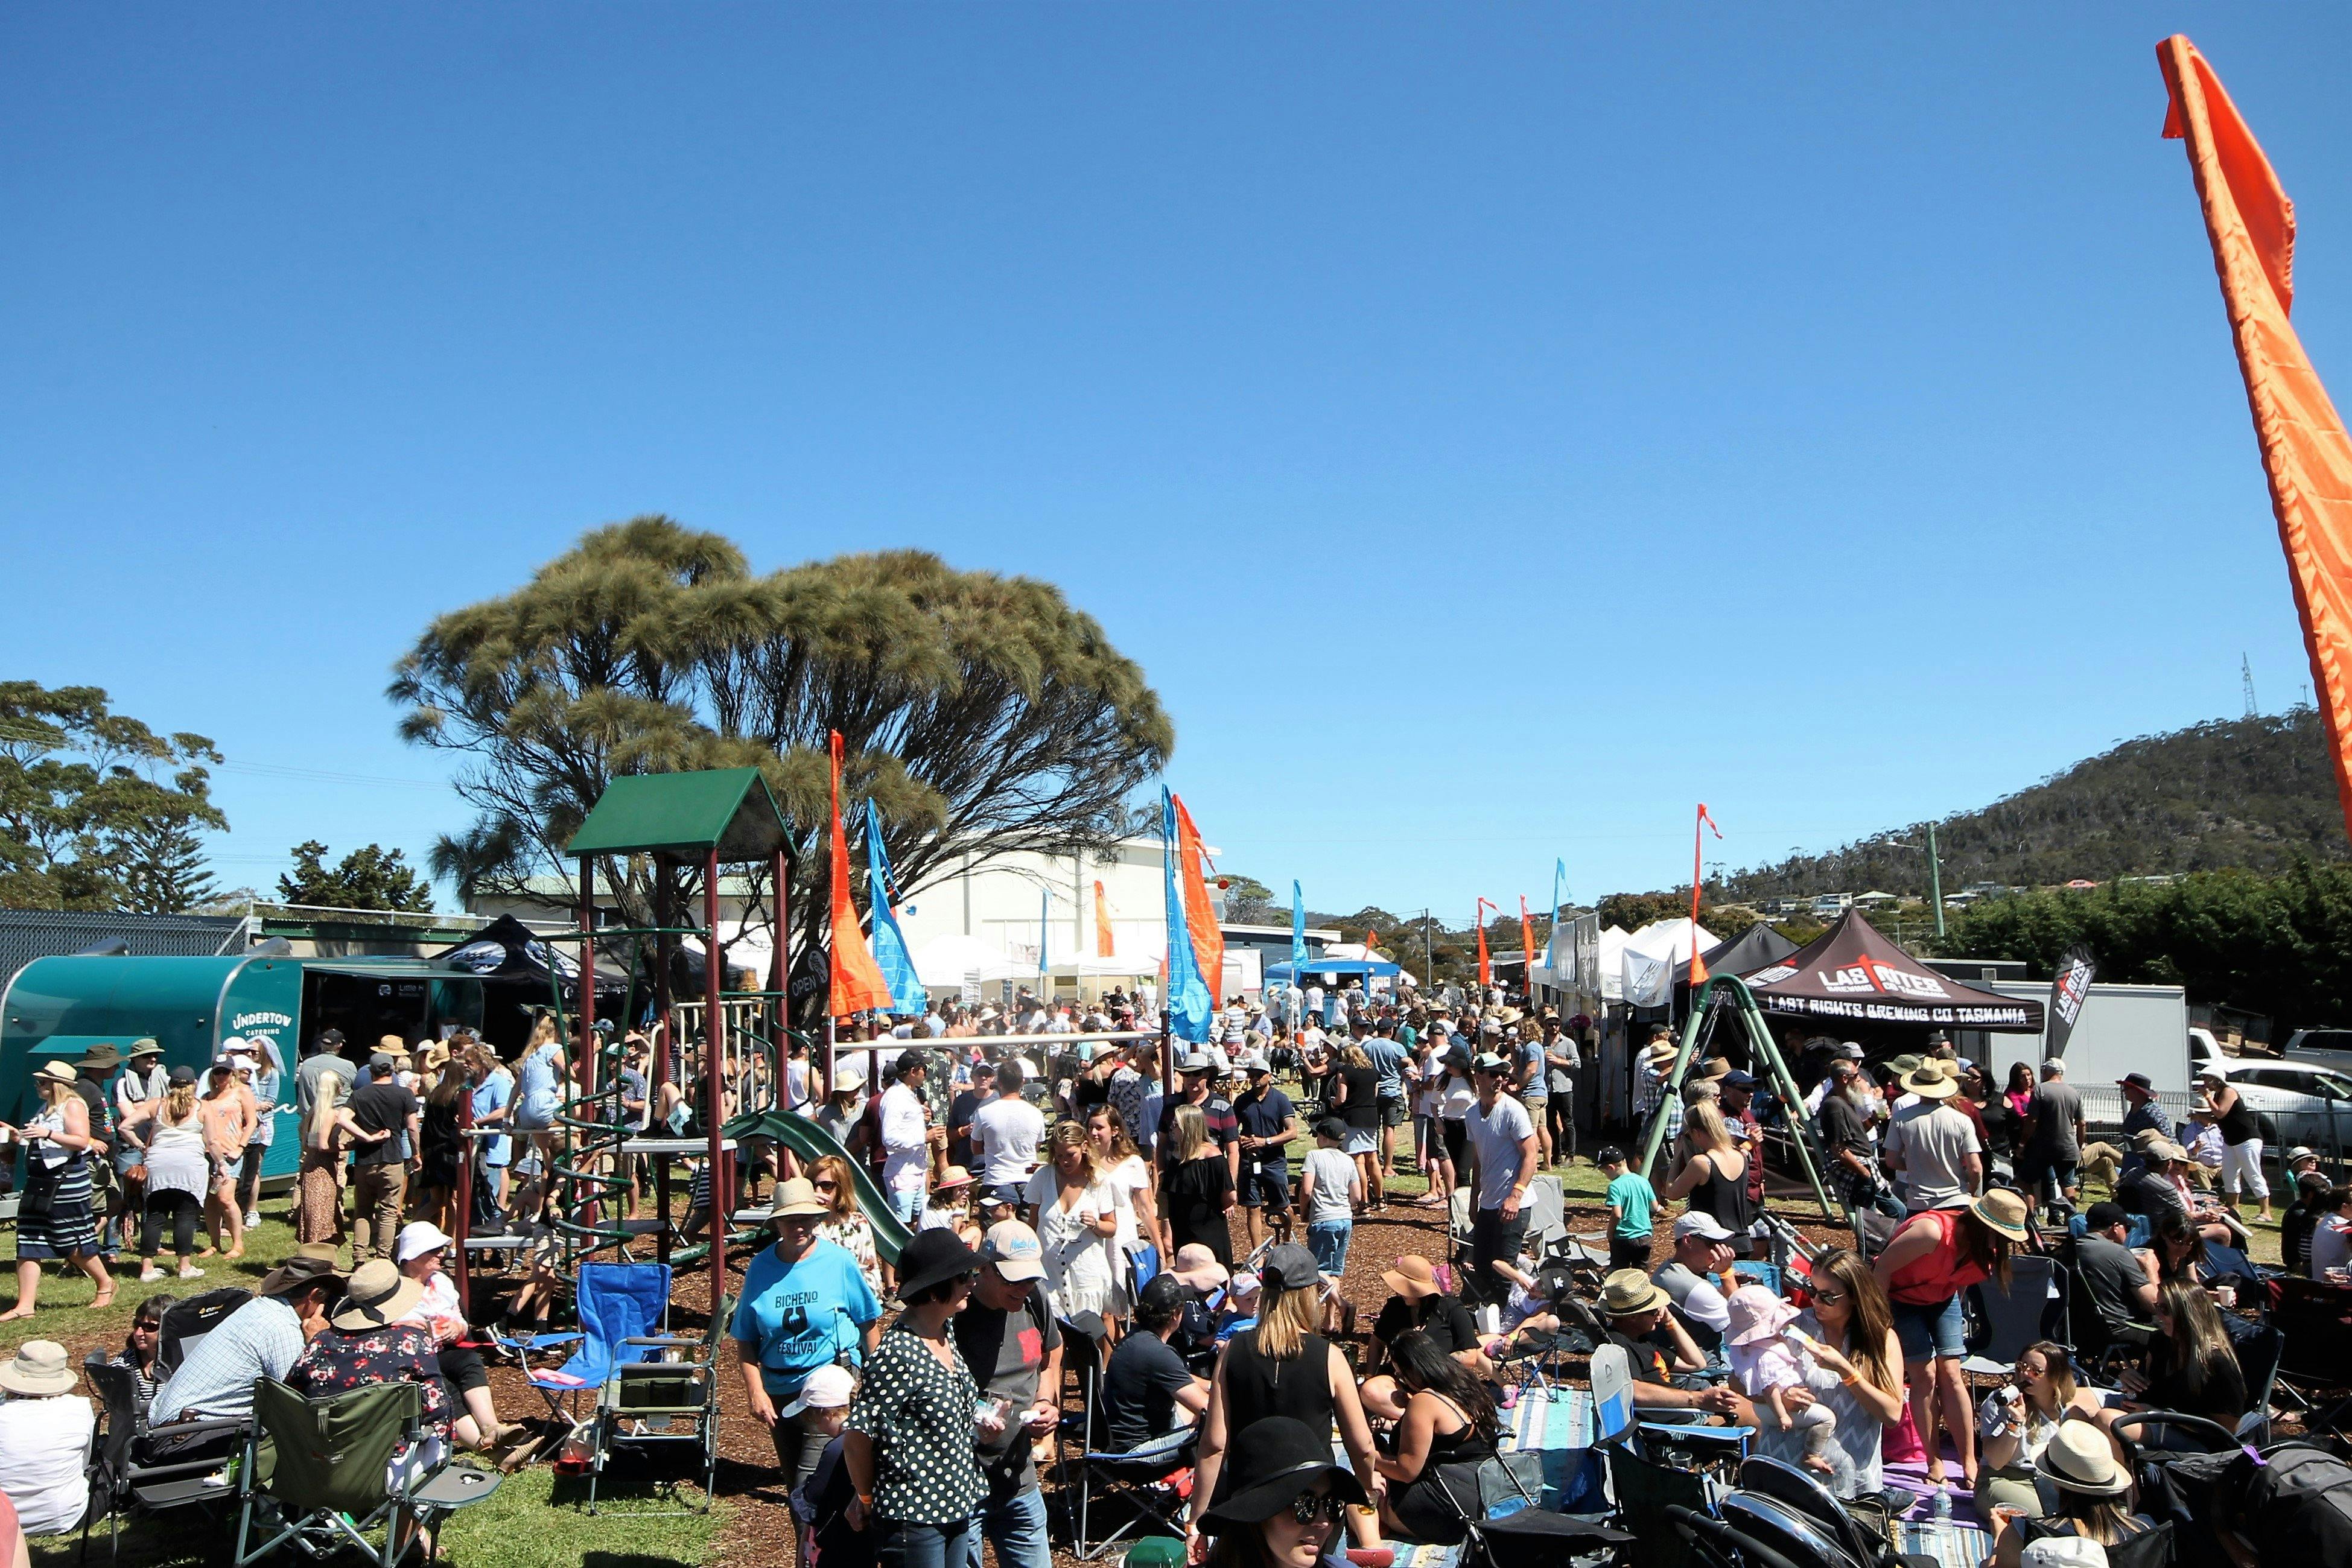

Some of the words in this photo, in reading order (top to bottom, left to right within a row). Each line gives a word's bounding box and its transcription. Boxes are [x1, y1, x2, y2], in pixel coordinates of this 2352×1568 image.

[792, 975, 816, 997] OPEN
[1768, 995, 1805, 1012] LAST
[1810, 999, 1864, 1018] RIGHTS
[1866, 1003, 1930, 1022] BREWING
[1932, 1008, 1954, 1023] CO
[1956, 1008, 2027, 1024] TASMANIA
[232, 1012, 293, 1030] UNDERTOW
[245, 1027, 281, 1036] CATERING
[775, 1290, 819, 1309] BICHENO
[777, 1341, 819, 1356] FESTIVAL
